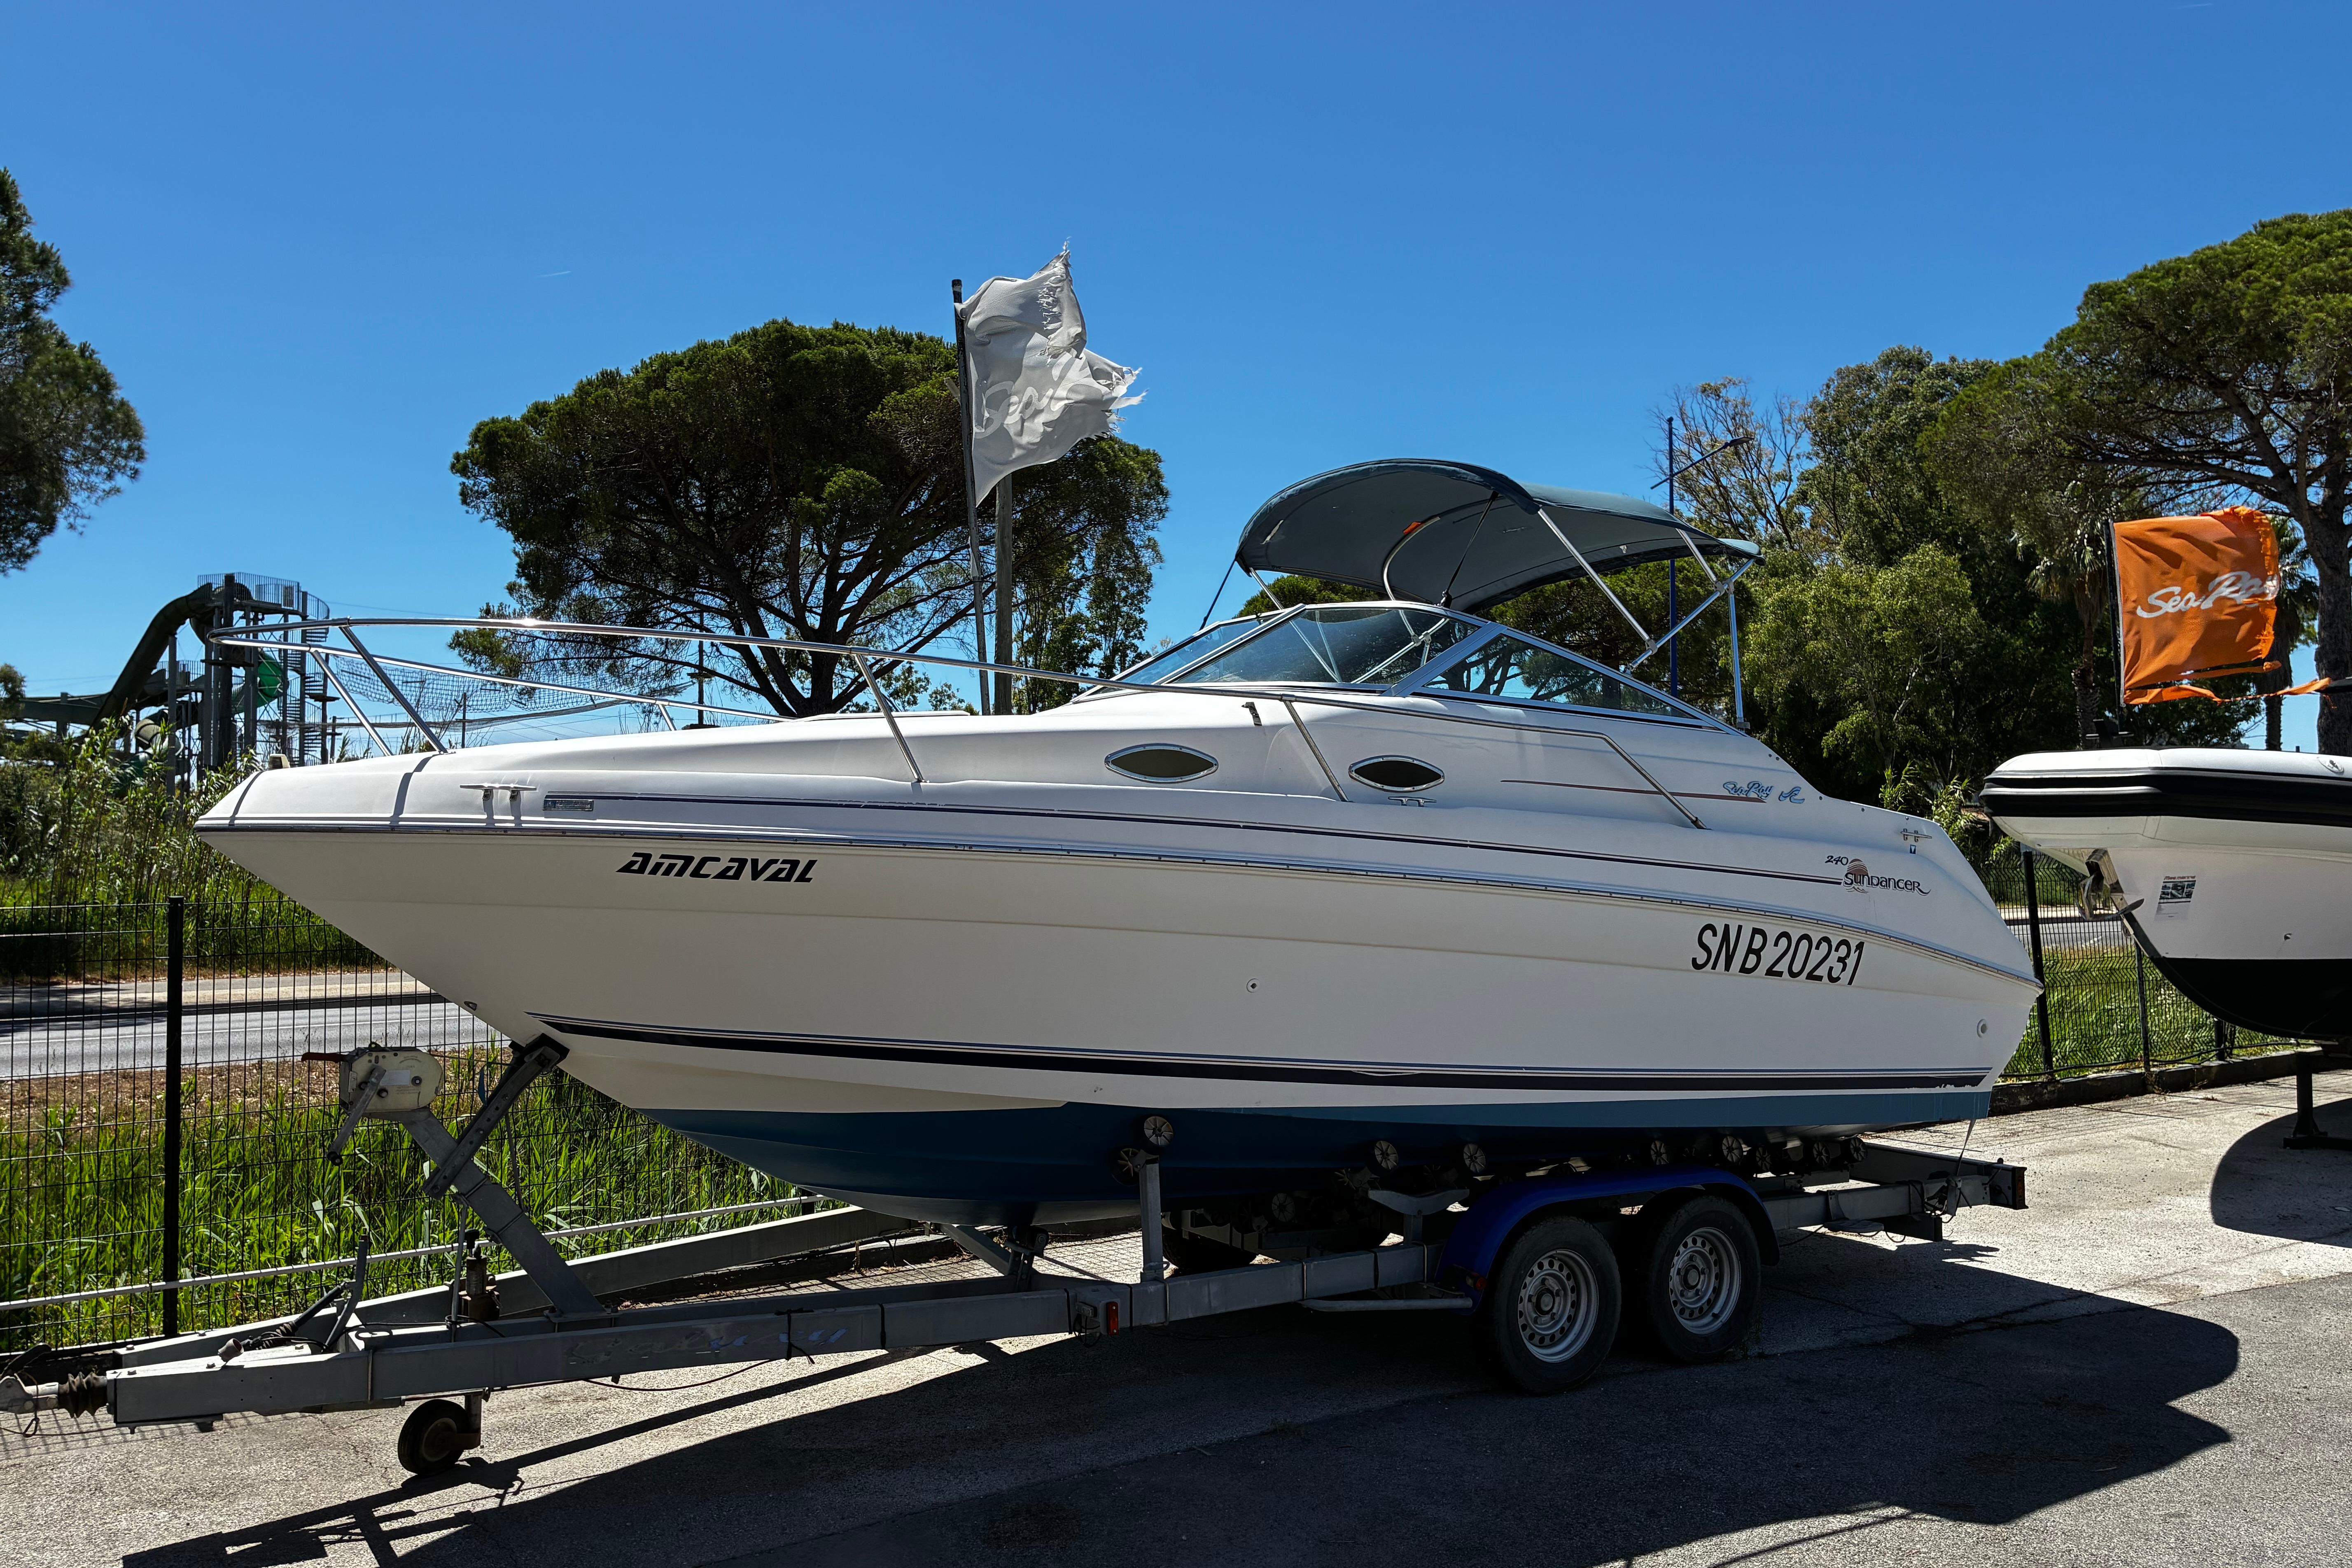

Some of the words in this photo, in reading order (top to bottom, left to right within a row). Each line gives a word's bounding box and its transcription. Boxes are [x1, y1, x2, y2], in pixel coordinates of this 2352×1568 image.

[2136, 586, 2206, 618] Sea
[1723, 782, 1748, 796] Sea
[1745, 781, 1774, 800] Ray
[1825, 855, 1849, 866] 240
[1691, 923, 1865, 985] SNB20231
